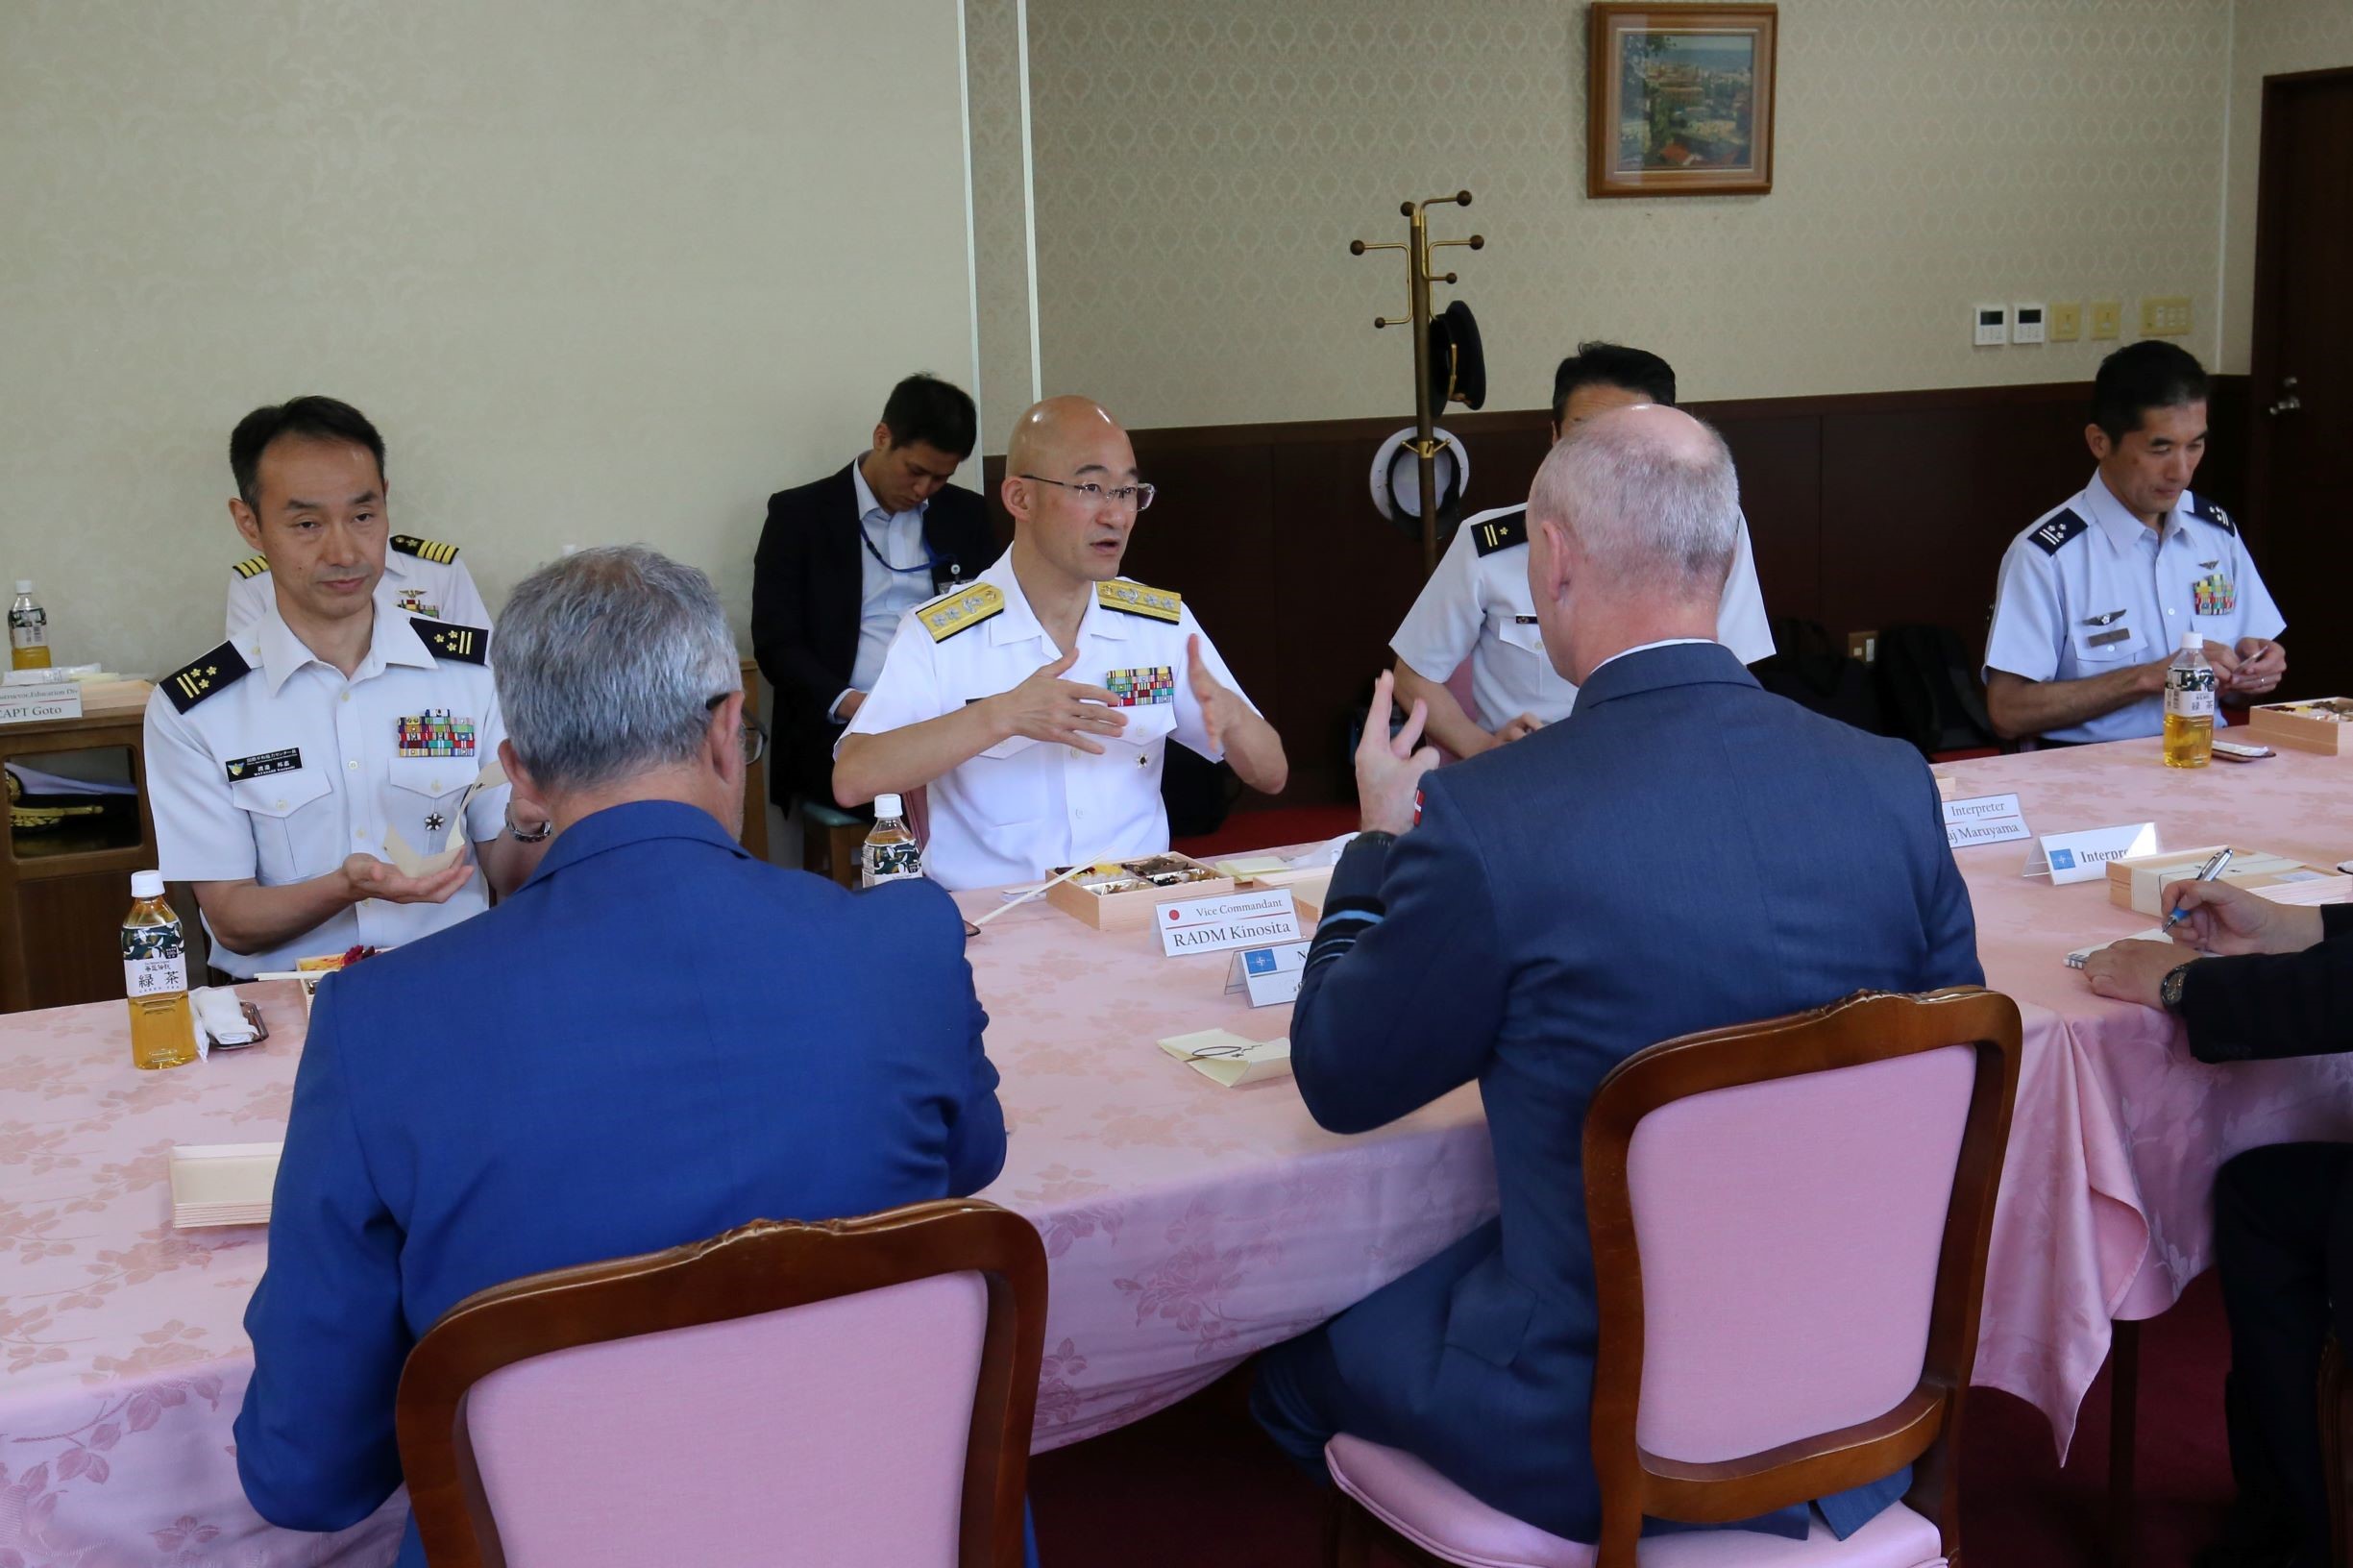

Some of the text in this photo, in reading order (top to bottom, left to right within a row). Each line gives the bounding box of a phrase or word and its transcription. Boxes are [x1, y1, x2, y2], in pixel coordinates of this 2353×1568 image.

[33, 706, 61, 716] Goto
[1951, 803, 2004, 817] Interpreter
[1958, 824, 2020, 839] Maruyama
[1196, 899, 1283, 917] Vice Commandant
[1173, 922, 1291, 946] RADM Kinosita
[138, 971, 180, 988] 緑茶
